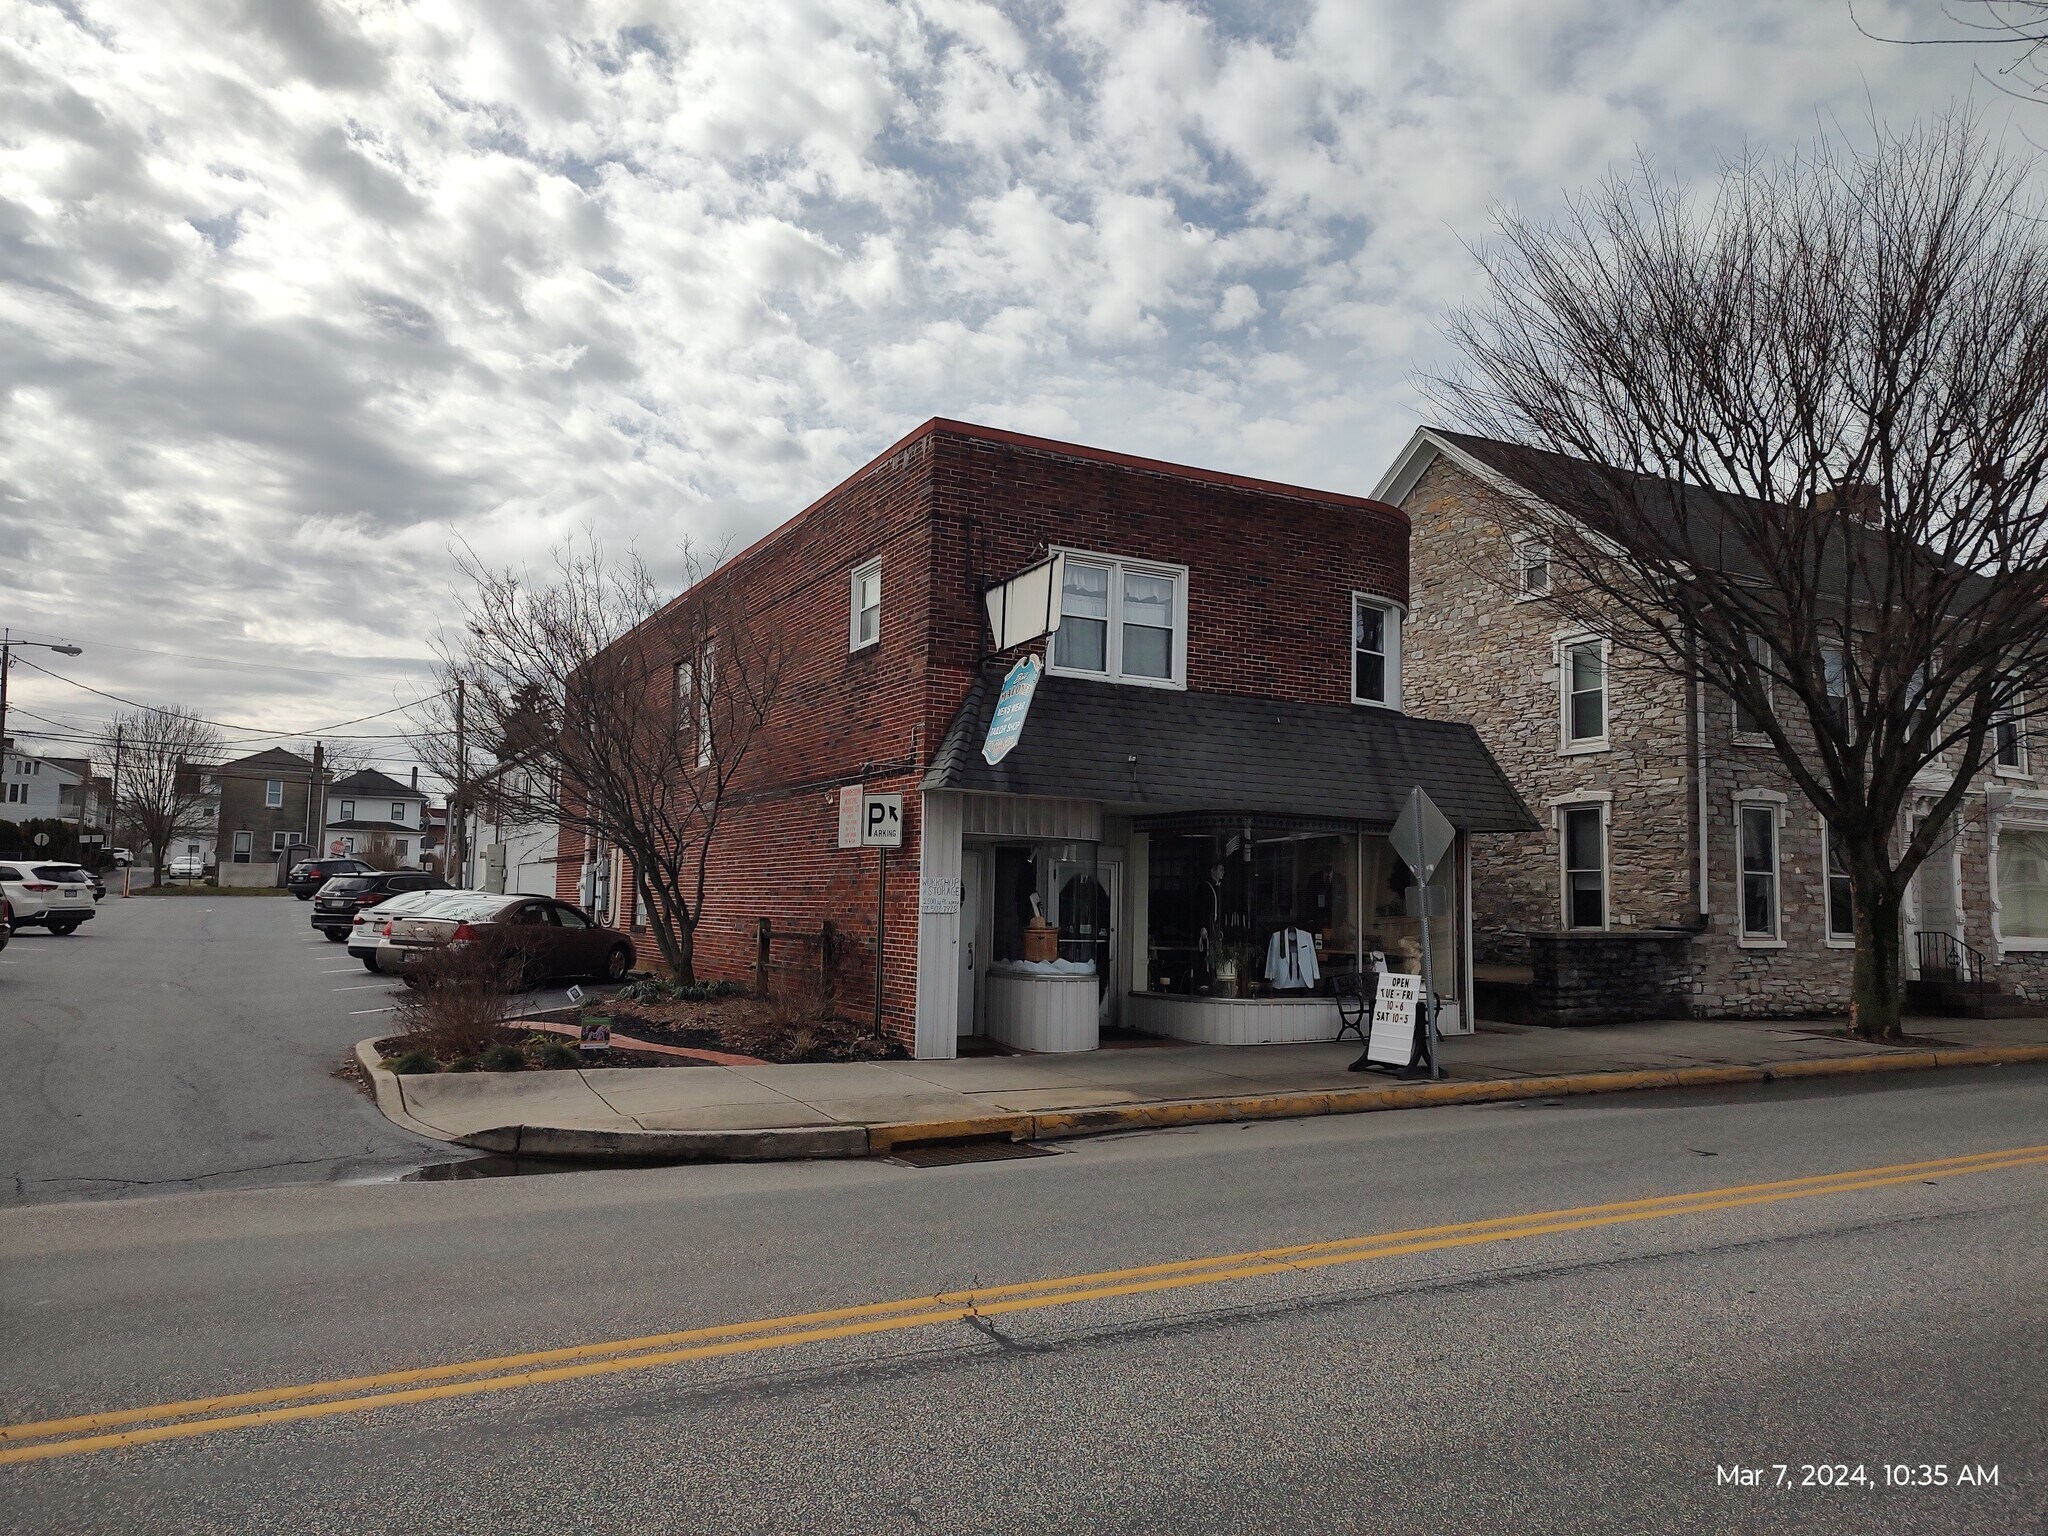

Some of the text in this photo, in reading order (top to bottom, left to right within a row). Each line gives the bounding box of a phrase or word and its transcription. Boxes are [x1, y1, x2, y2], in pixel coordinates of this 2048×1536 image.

[1007, 721, 1021, 733] SHOP
[929, 885, 959, 896] STORAGE
[1392, 977, 1410, 988] OPEN
[1381, 988, 1394, 999] TUE
[1402, 990, 1414, 1000] FRI
[1376, 1011, 1389, 1022] SAT
